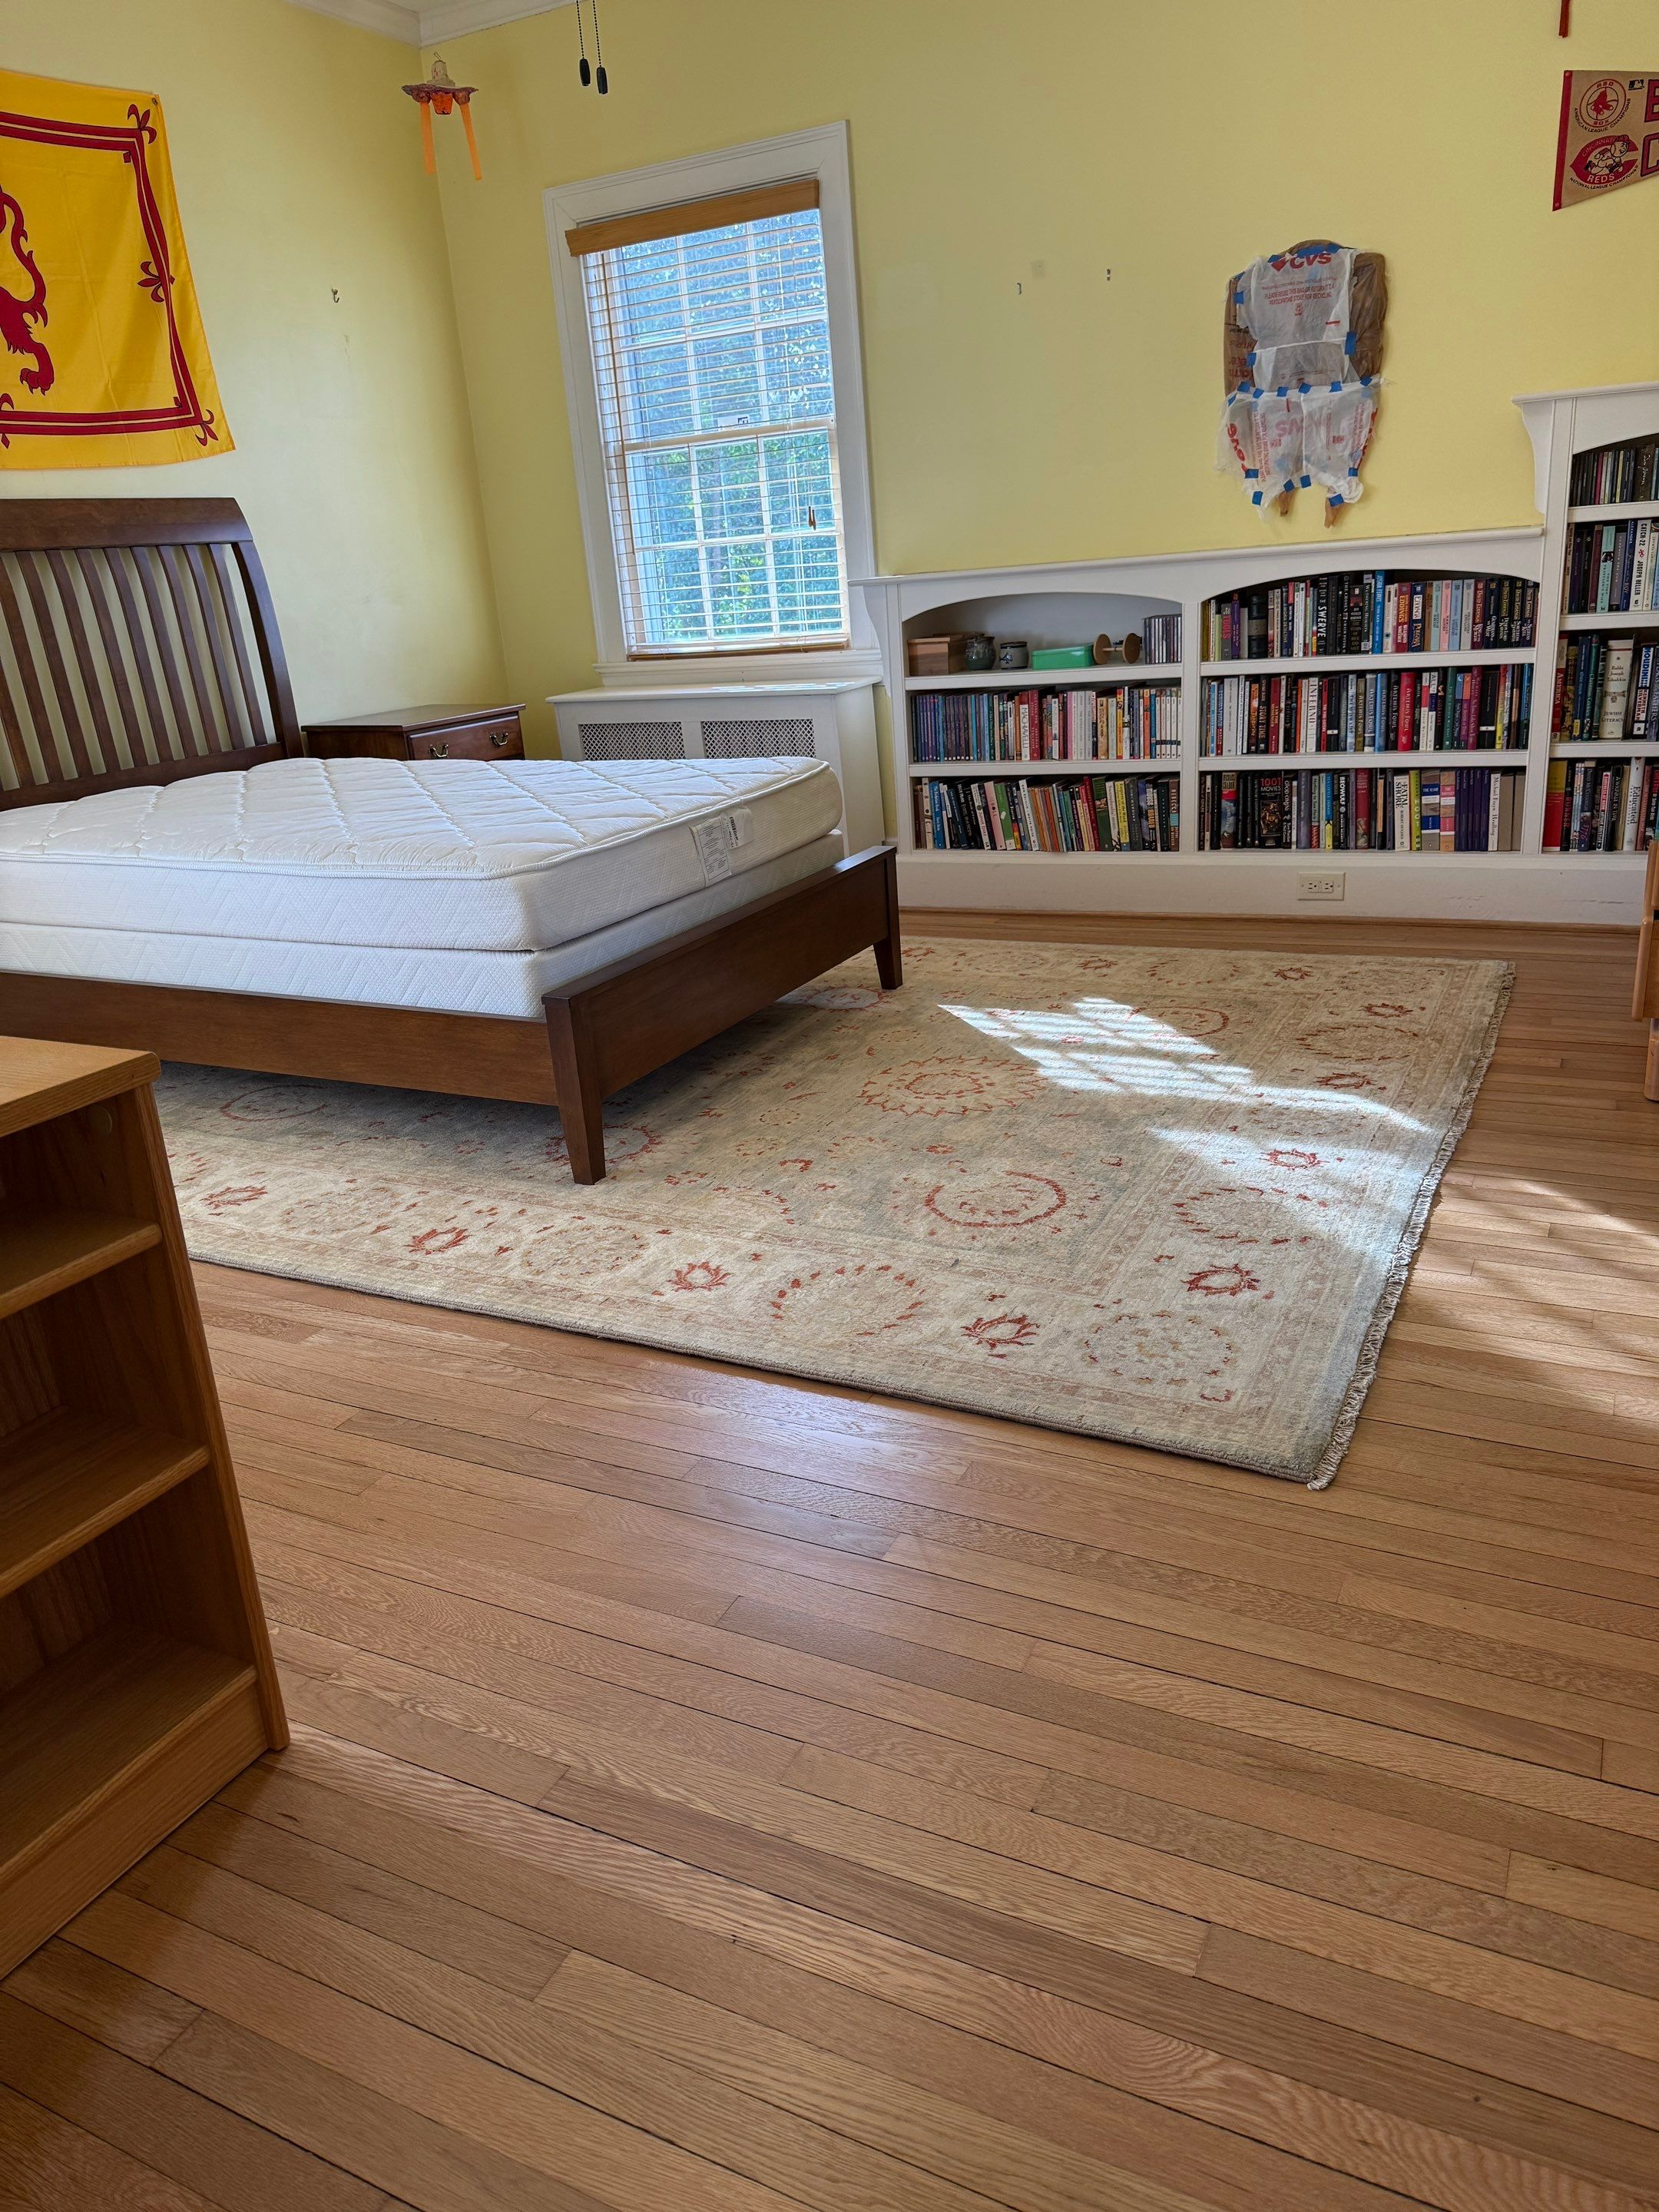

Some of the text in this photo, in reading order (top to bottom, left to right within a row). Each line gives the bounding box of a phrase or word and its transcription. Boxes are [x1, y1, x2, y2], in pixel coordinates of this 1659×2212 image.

[1574, 108, 1588, 131] AMERICAN
[1611, 98, 1631, 129] CHAMPIONS
[1570, 177, 1590, 189] NATIONAL
[1588, 174, 1615, 184] REDS
[1290, 253, 1333, 270] CVS
[1317, 606, 1326, 637] SWERVE
[1555, 673, 1564, 704] AMERICA
[1260, 777, 1281, 786] 1001
[1630, 786, 1641, 824] Educated
[1581, 825, 1589, 841] 1776
